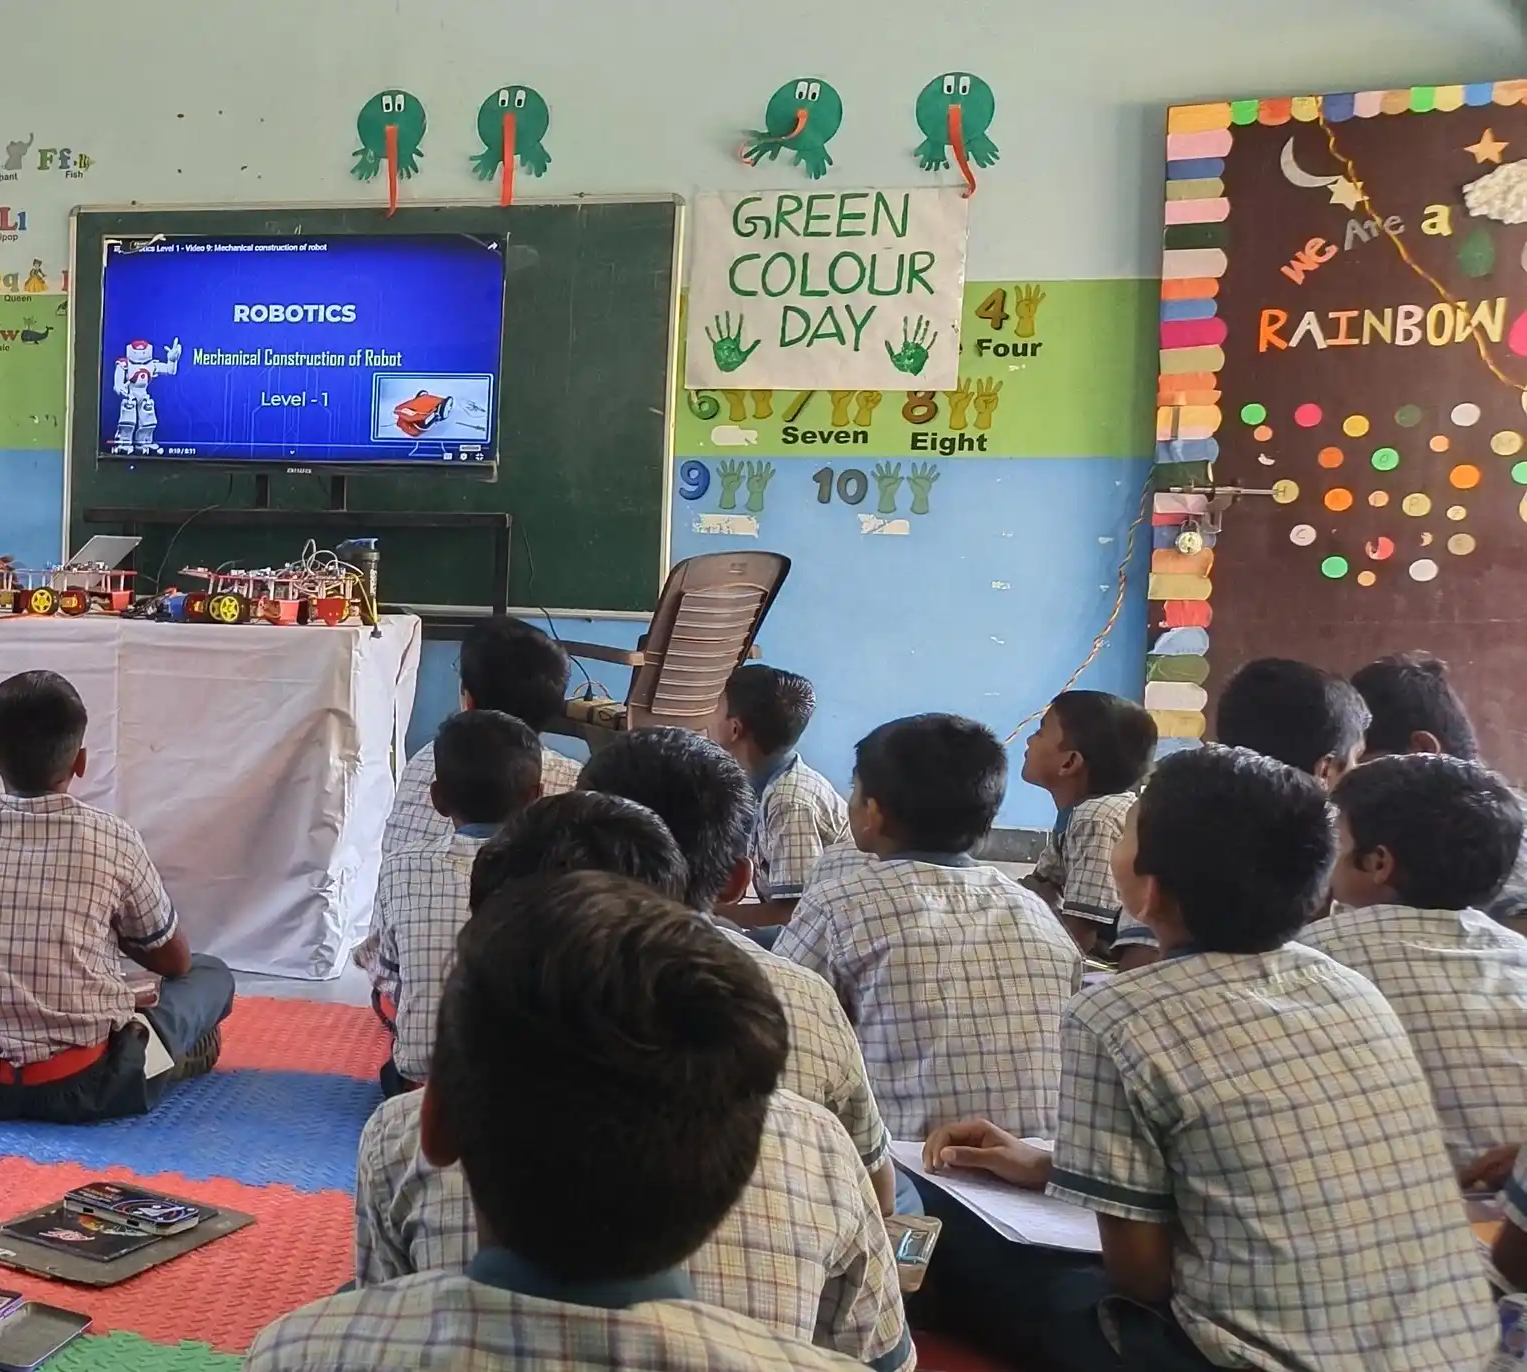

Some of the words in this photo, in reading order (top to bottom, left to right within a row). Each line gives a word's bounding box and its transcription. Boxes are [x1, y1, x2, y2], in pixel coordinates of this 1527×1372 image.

[37, 148, 72, 170] Ff
[65, 170, 84, 179] Fish
[732, 191, 910, 240] GREEN
[1420, 203, 1453, 237] a
[156, 244, 175, 253] Level
[186, 243, 205, 253] Video
[214, 243, 253, 252] Mechanical
[254, 243, 298, 252] construction
[308, 243, 327, 252] robot
[728, 251, 936, 297] COLOUR
[4, 294, 32, 303] Queen
[975, 288, 1009, 330] 4
[233, 304, 357, 324] ROBOTICS
[1259, 296, 1508, 353] RAINBOW
[779, 304, 877, 352] DAY
[192, 349, 261, 367] Mechanical
[264, 349, 346, 367] Construction
[348, 349, 362, 367] of
[364, 349, 402, 367] Robot
[975, 338, 1043, 358] Four
[261, 391, 307, 408] Level
[321, 391, 329, 407] 1
[781, 426, 869, 445] Seven
[910, 431, 989, 456] Eight
[678, 459, 711, 500] 9
[812, 466, 869, 506] 10
